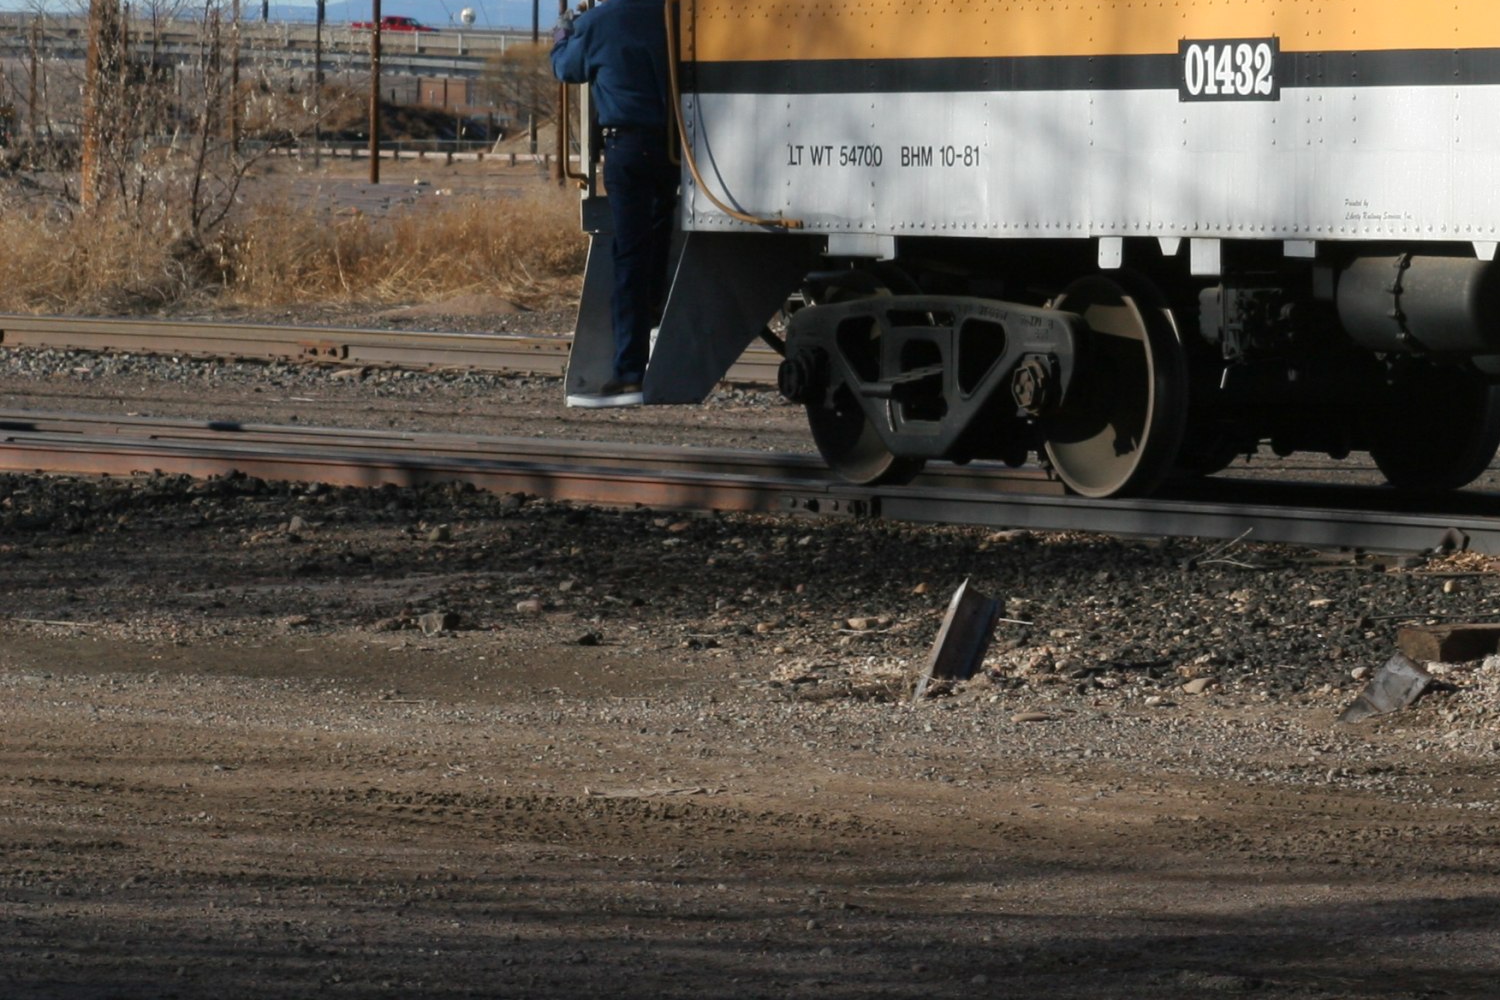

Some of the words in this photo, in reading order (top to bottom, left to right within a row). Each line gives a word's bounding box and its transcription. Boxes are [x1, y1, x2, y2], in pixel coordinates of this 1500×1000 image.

[1184, 42, 1273, 96] 01432
[789, 145, 804, 166] LT
[810, 145, 833, 166] WT
[839, 145, 883, 167] 54700
[901, 145, 933, 167] BHM
[939, 145, 980, 167] 10-81
